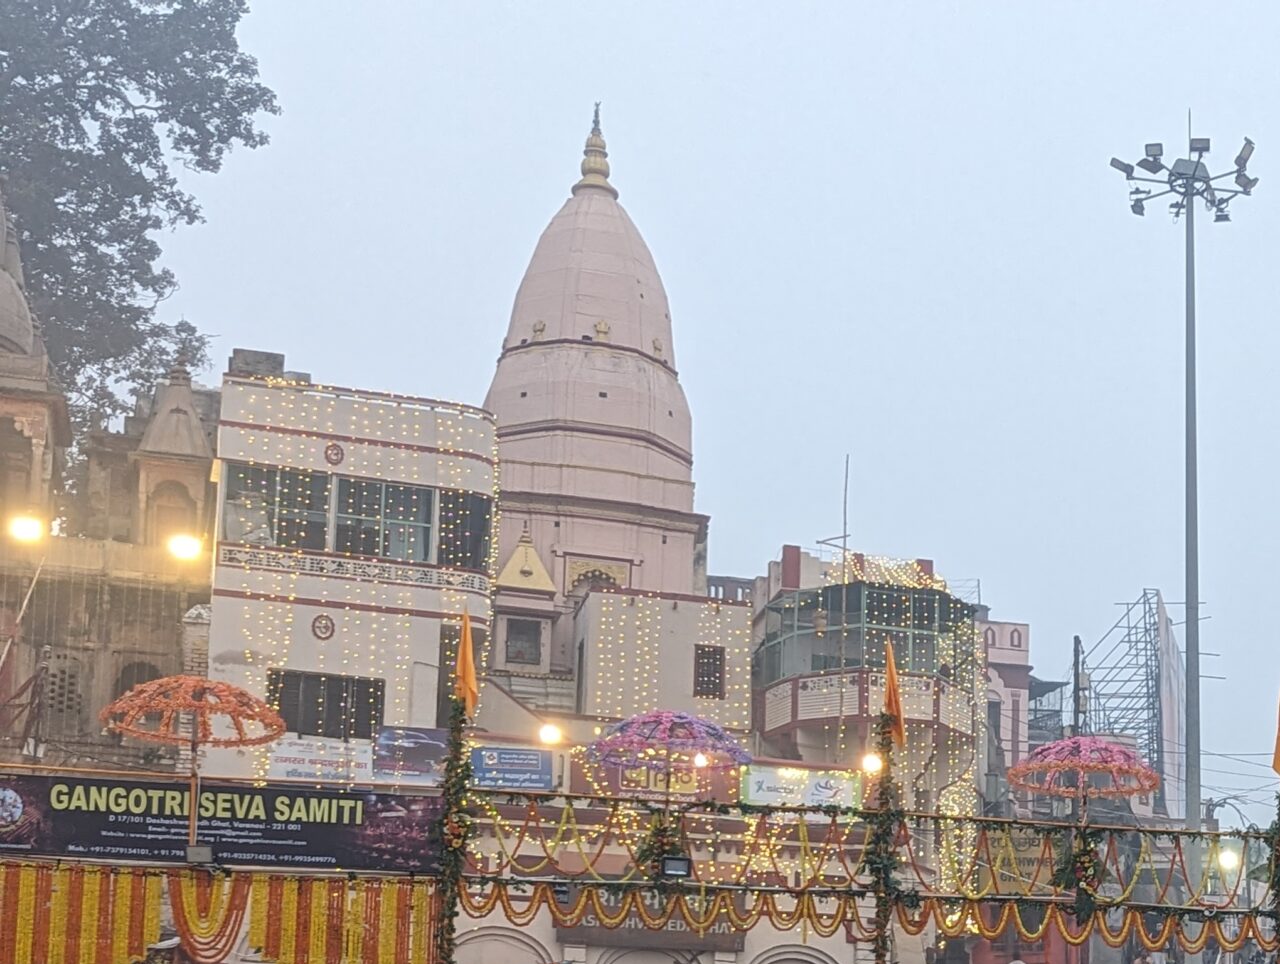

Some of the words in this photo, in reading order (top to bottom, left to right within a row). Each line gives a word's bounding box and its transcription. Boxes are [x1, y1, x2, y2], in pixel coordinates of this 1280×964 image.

[50, 784, 189, 816] GANGOTRI
[200, 792, 267, 820] SEVA
[274, 796, 363, 825] SAMITI
